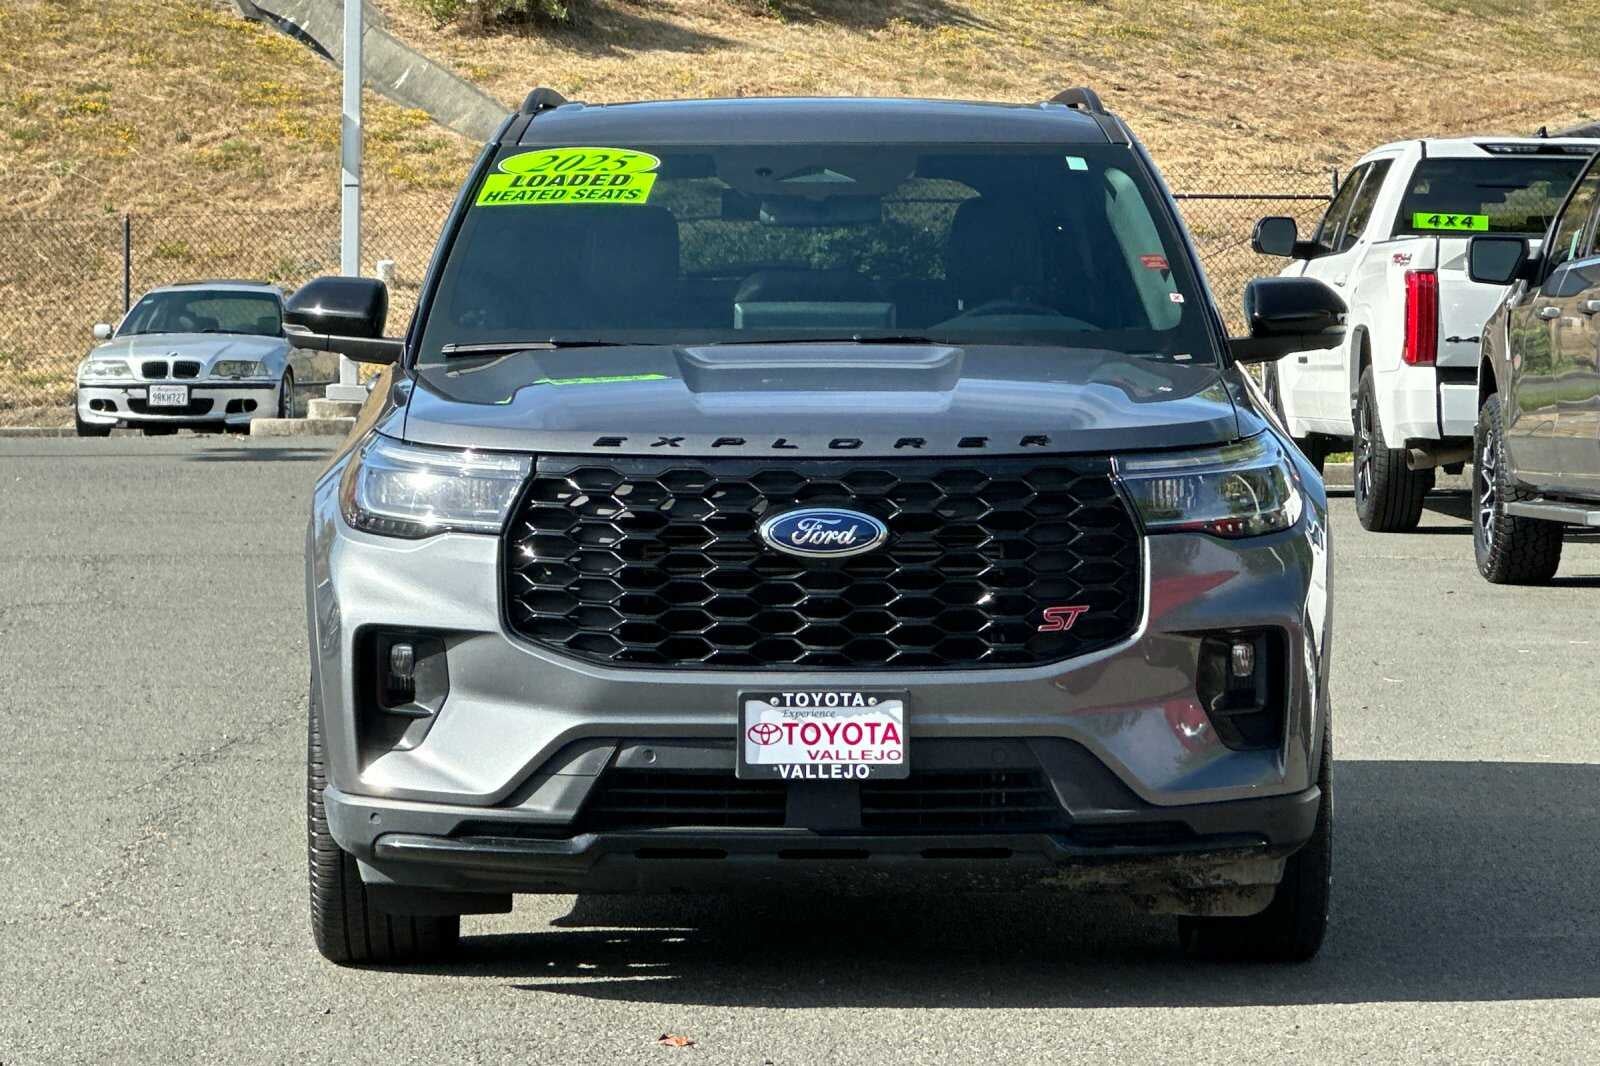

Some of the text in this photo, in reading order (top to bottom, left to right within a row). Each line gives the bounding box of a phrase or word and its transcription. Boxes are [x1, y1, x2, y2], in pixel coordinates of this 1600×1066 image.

[524, 153, 637, 174] 2025
[509, 173, 633, 188] LOADED
[484, 188, 642, 202] HEATED SEATS
[592, 434, 1051, 450] EXPLORER
[791, 517, 859, 545] Ford
[1037, 605, 1090, 632] ST
[782, 692, 865, 707] TOYOTA
[782, 709, 836, 719] Experience
[782, 722, 901, 746] TOYOTA
[807, 749, 902, 761] VALLEJO
[778, 764, 870, 779] VALLEJO
